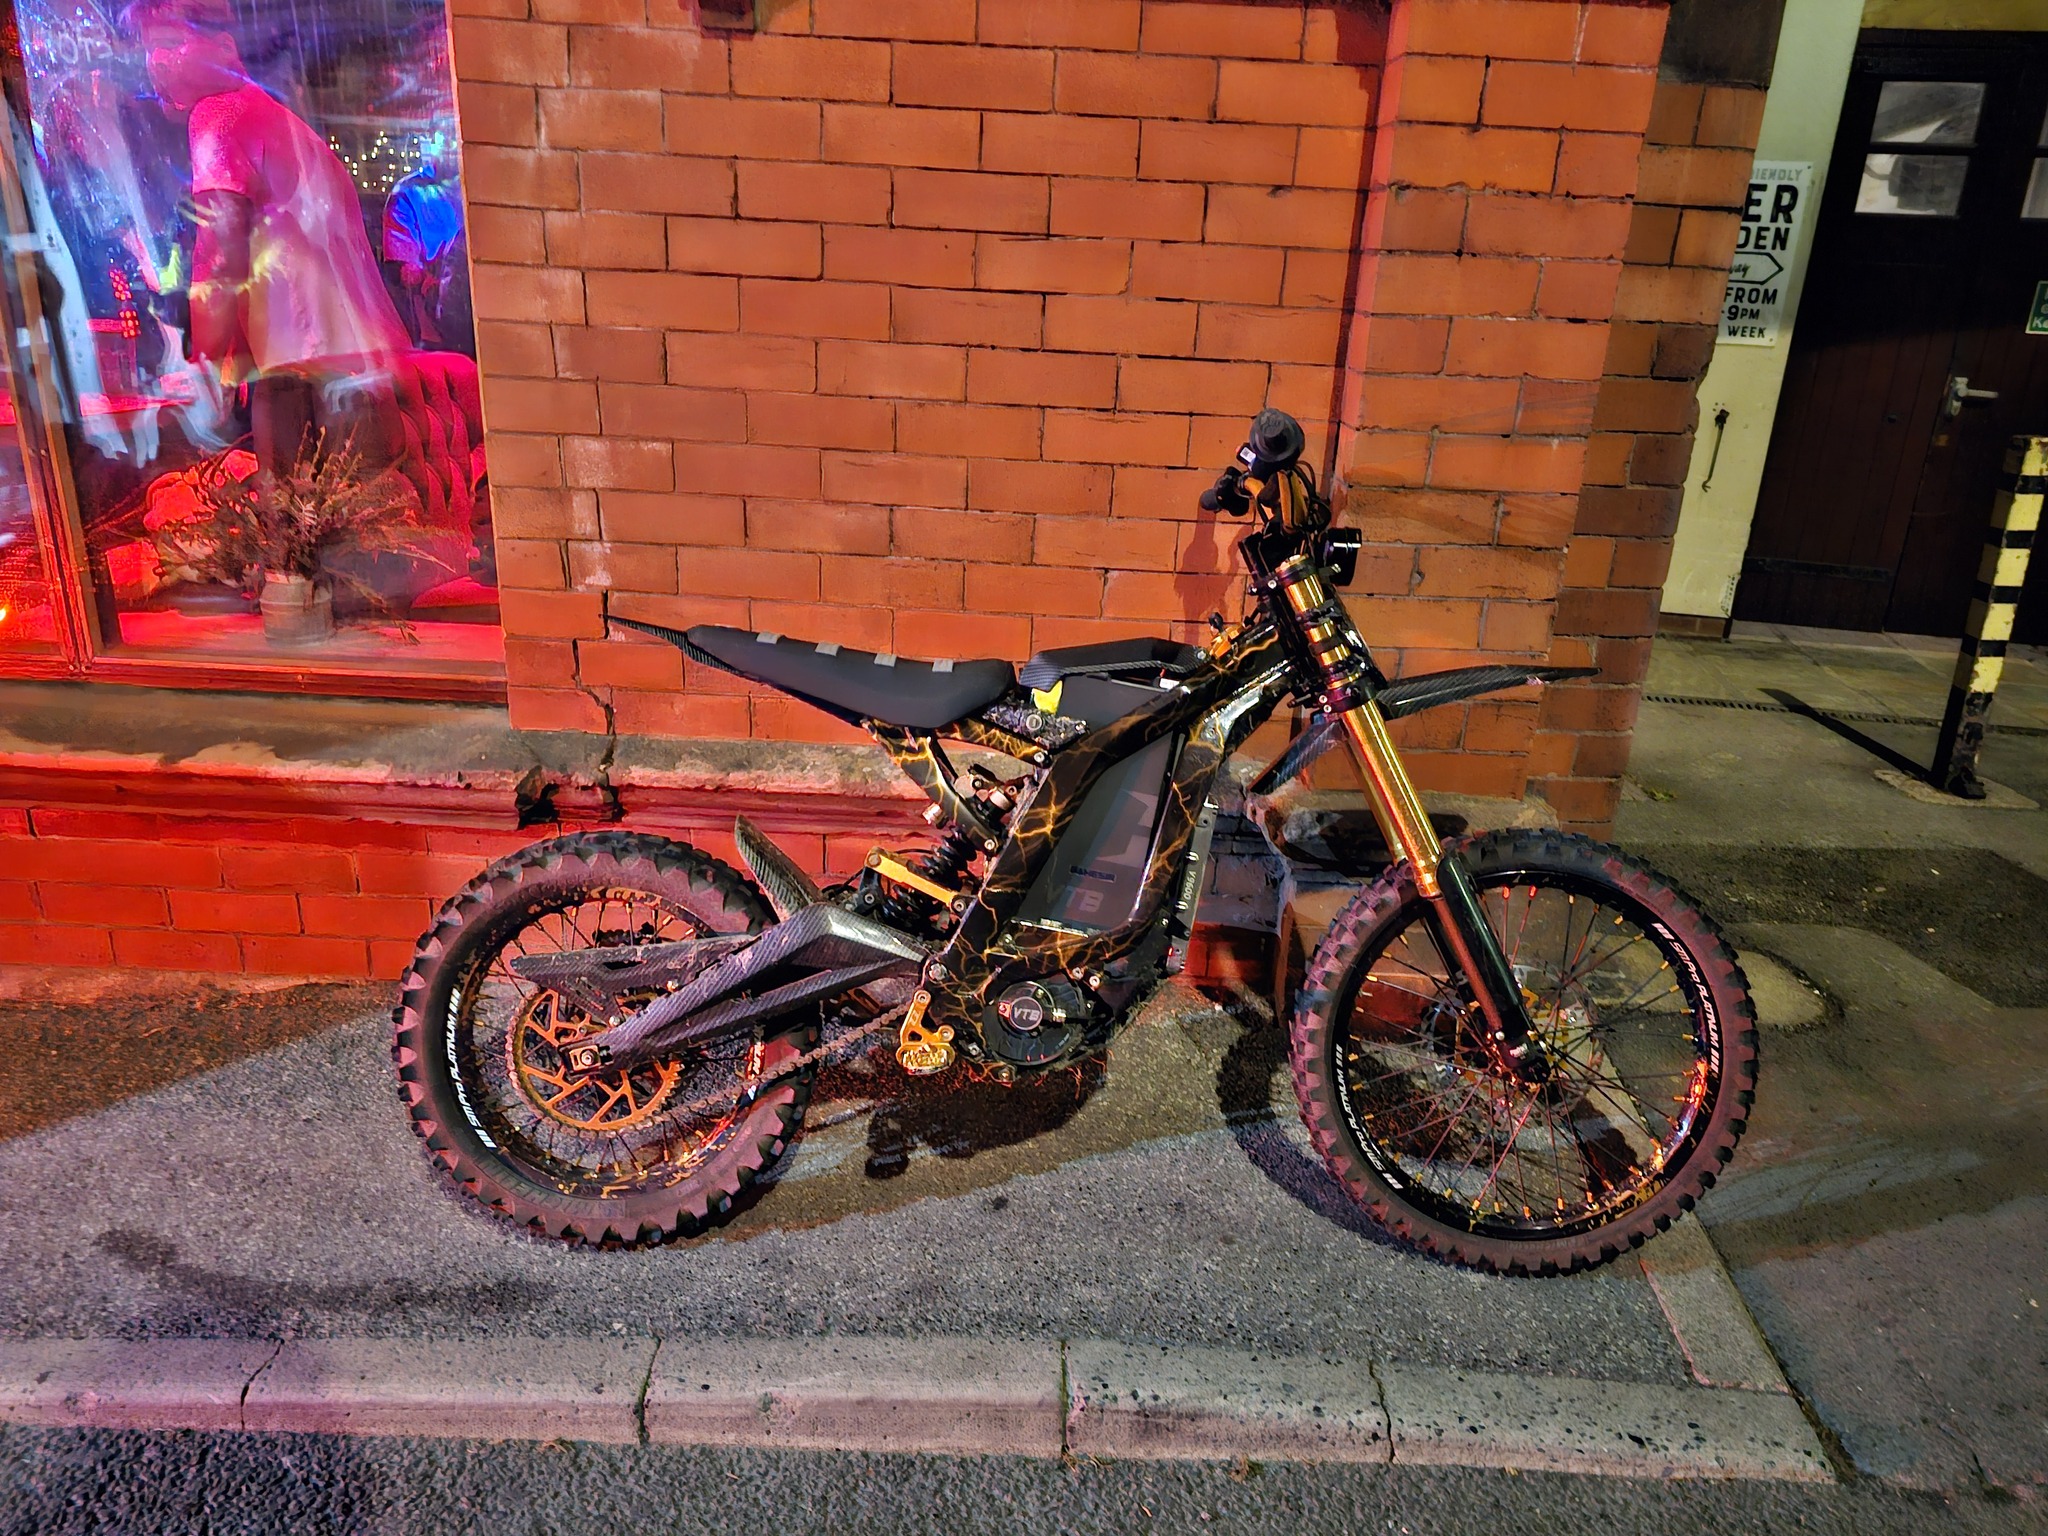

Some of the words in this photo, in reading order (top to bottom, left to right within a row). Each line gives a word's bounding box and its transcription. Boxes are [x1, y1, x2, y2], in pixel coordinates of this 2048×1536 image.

[1742, 183, 1799, 223] ER
[1736, 226, 1790, 251] DEN
[1724, 287, 1778, 305] FROM
[1728, 325, 1766, 338] WEEK
[1696, 983, 1720, 1048] PLATINUM
[446, 1013, 462, 1081] PLATINUM
[1337, 1068, 1360, 1130] PLATINUM
